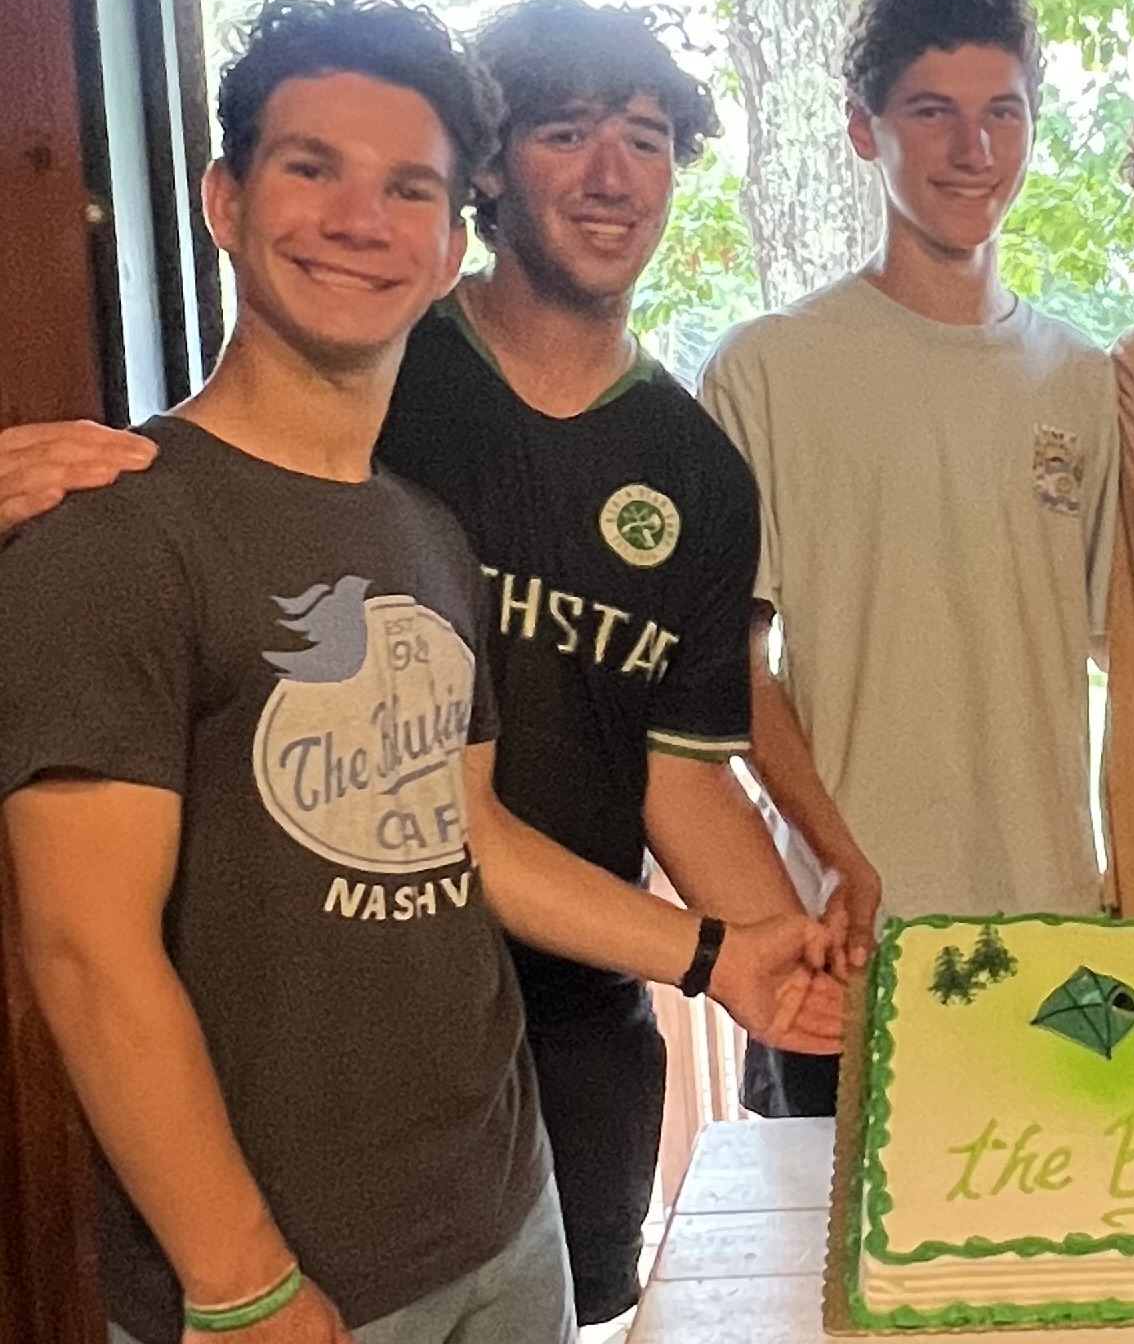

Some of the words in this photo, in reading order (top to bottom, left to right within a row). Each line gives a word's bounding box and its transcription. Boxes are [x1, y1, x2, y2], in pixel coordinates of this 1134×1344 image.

[279, 731, 369, 812] The
[376, 802, 467, 850] CAF
[323, 872, 472, 921] NASHV
[946, 1118, 1073, 1202] the
